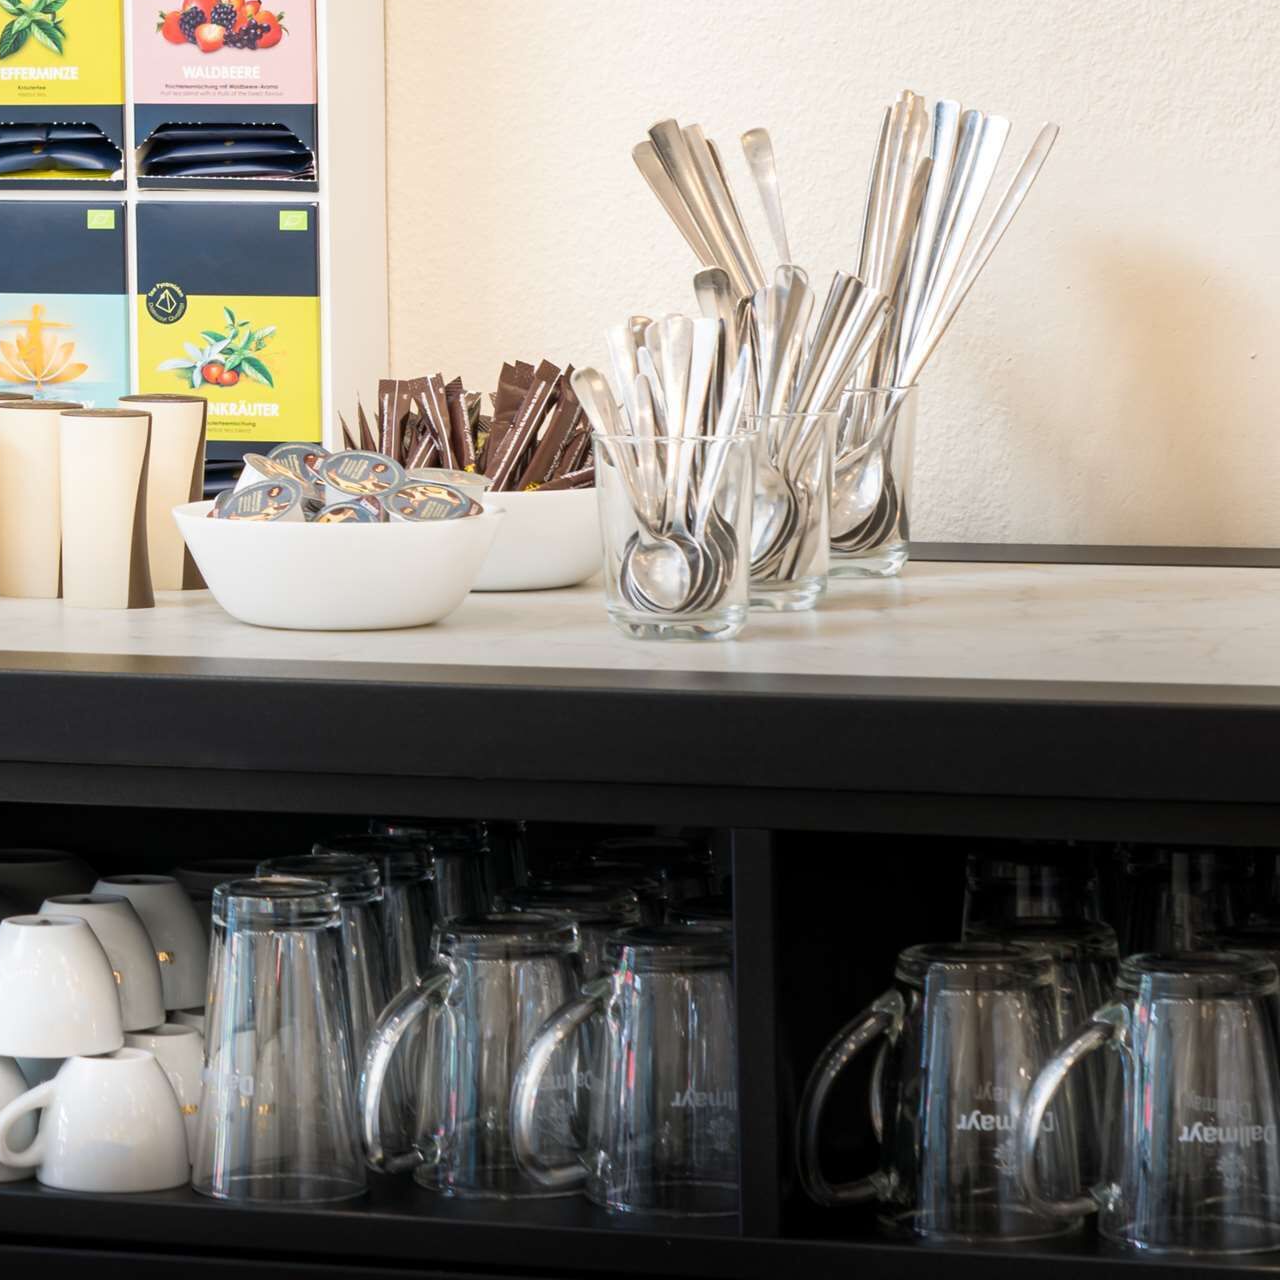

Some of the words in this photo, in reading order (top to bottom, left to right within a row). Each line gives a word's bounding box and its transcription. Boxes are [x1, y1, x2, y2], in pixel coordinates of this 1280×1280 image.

[182, 65, 261, 79] WALDBEERE
[207, 400, 279, 417] NKRÄUTER
[671, 1088, 737, 1111] llmayr
[956, 1110, 1055, 1133] Dmayr
